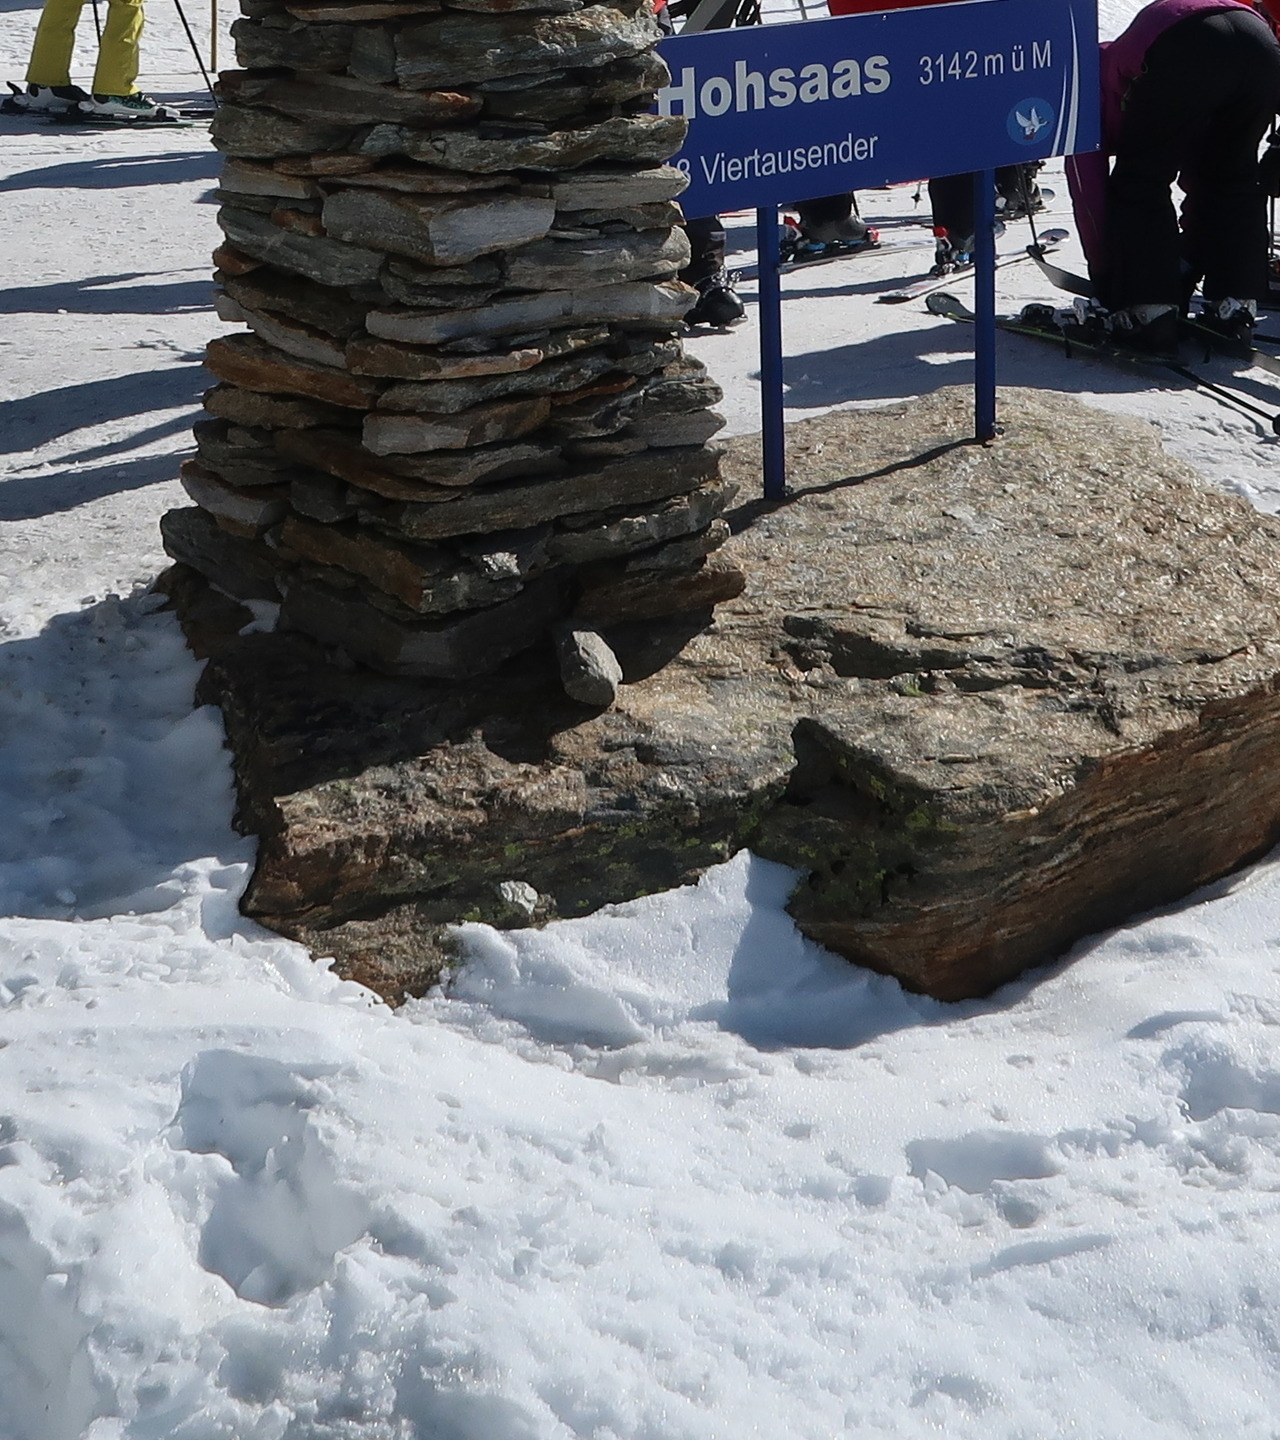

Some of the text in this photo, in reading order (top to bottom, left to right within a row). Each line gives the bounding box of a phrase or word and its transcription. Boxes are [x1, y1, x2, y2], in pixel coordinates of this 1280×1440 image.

[657, 39, 1053, 120] Hohsaas 3142 m ü M
[700, 132, 880, 186] Viertausender
